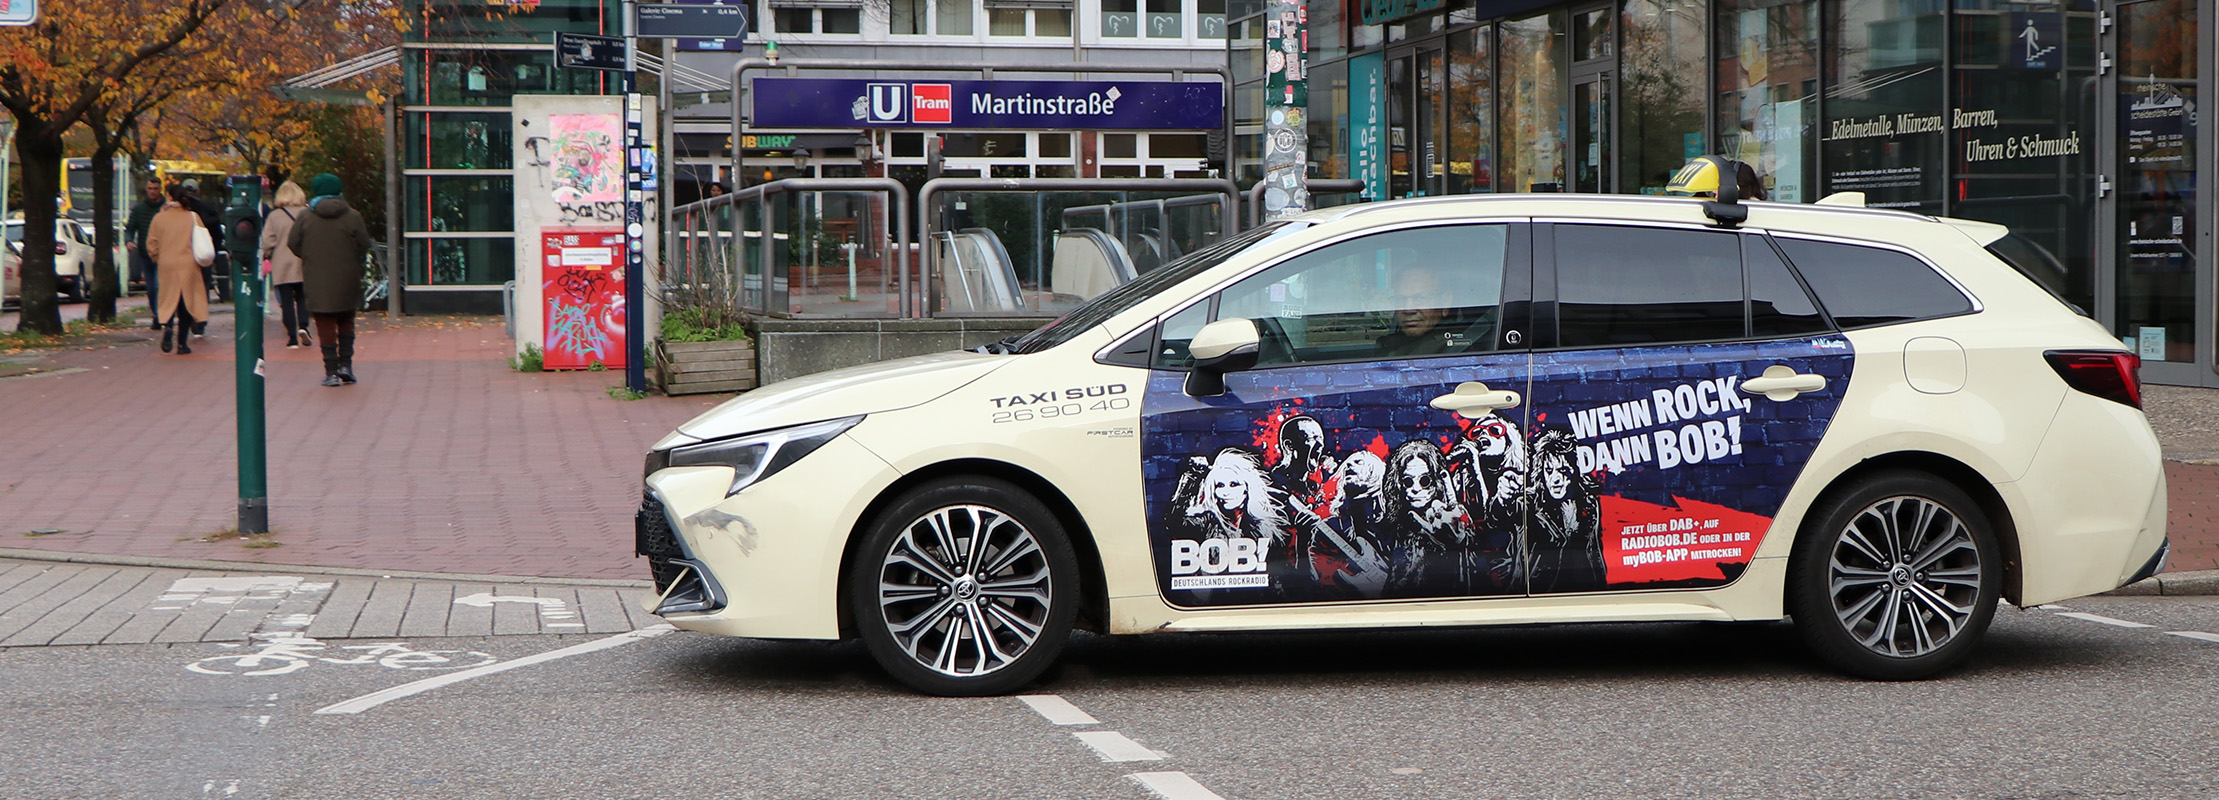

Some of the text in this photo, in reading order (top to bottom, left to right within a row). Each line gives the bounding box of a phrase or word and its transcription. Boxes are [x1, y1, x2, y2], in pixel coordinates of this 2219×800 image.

[873, 86, 900, 120] U
[914, 95, 949, 110] Tram
[971, 92, 1115, 115] Martinstraße
[1896, 112, 1945, 136] Münzen,
[1952, 107, 1999, 130] Barren,
[1965, 131, 2080, 162] Uhren & Schmuck
[990, 383, 1127, 408] TAXI SÜD
[1567, 375, 1751, 440] WENN ROCK,
[992, 397, 1130, 423] 26 90 40
[1576, 415, 1743, 475] DANN BOB!
[1621, 525, 1645, 535] JETZT
[1646, 523, 1667, 533] ÜBER
[1703, 519, 1720, 529] AUF
[1621, 532, 1750, 550] RADIOBOB.DE ODER IN DER
[1171, 537, 1270, 575] BOB!
[1622, 548, 1742, 568] myBOB-APP MITROCKEN!
[1173, 575, 1266, 587] DEUTSCHLANDS ROCKRADIO
